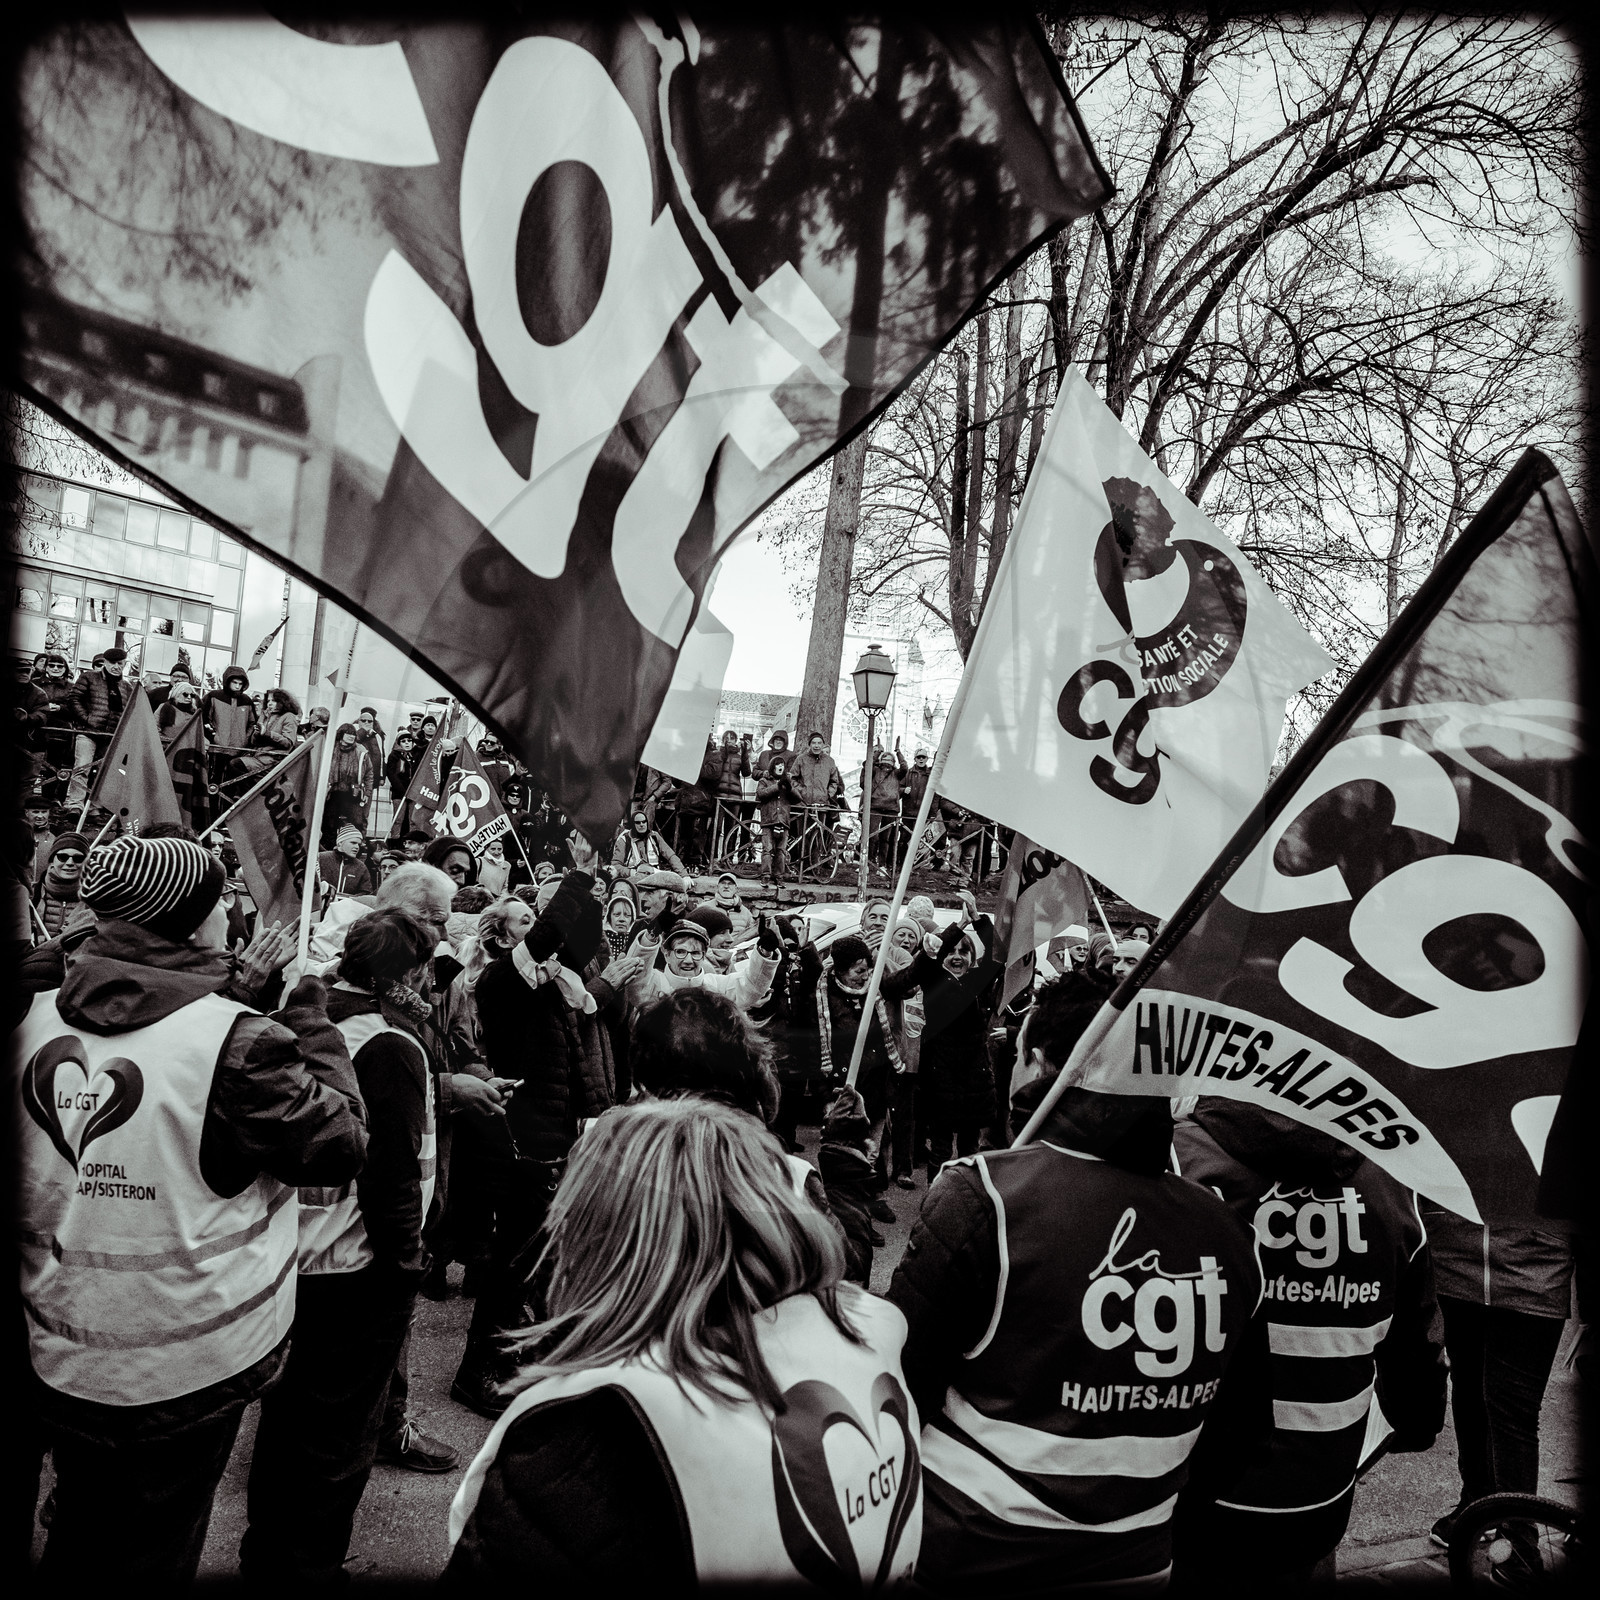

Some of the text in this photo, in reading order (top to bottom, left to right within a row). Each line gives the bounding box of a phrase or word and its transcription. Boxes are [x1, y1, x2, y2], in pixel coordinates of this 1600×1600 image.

[1136, 623, 1198, 668] SANTÉ ET
[1178, 632, 1229, 686] SOCIALE
[789, 889, 817, 904] PAS
[826, 892, 844, 903] DE
[57, 1091, 100, 1111] La CGT
[1132, 1002, 1419, 1150] HAUTES-ALPES
[1088, 1207, 1224, 1280] la
[1253, 1187, 1368, 1269] cgt
[1081, 1256, 1228, 1378] cgt
[1061, 1377, 1221, 1414] HAUTES-ALPES
[845, 1456, 897, 1525] La CGT
